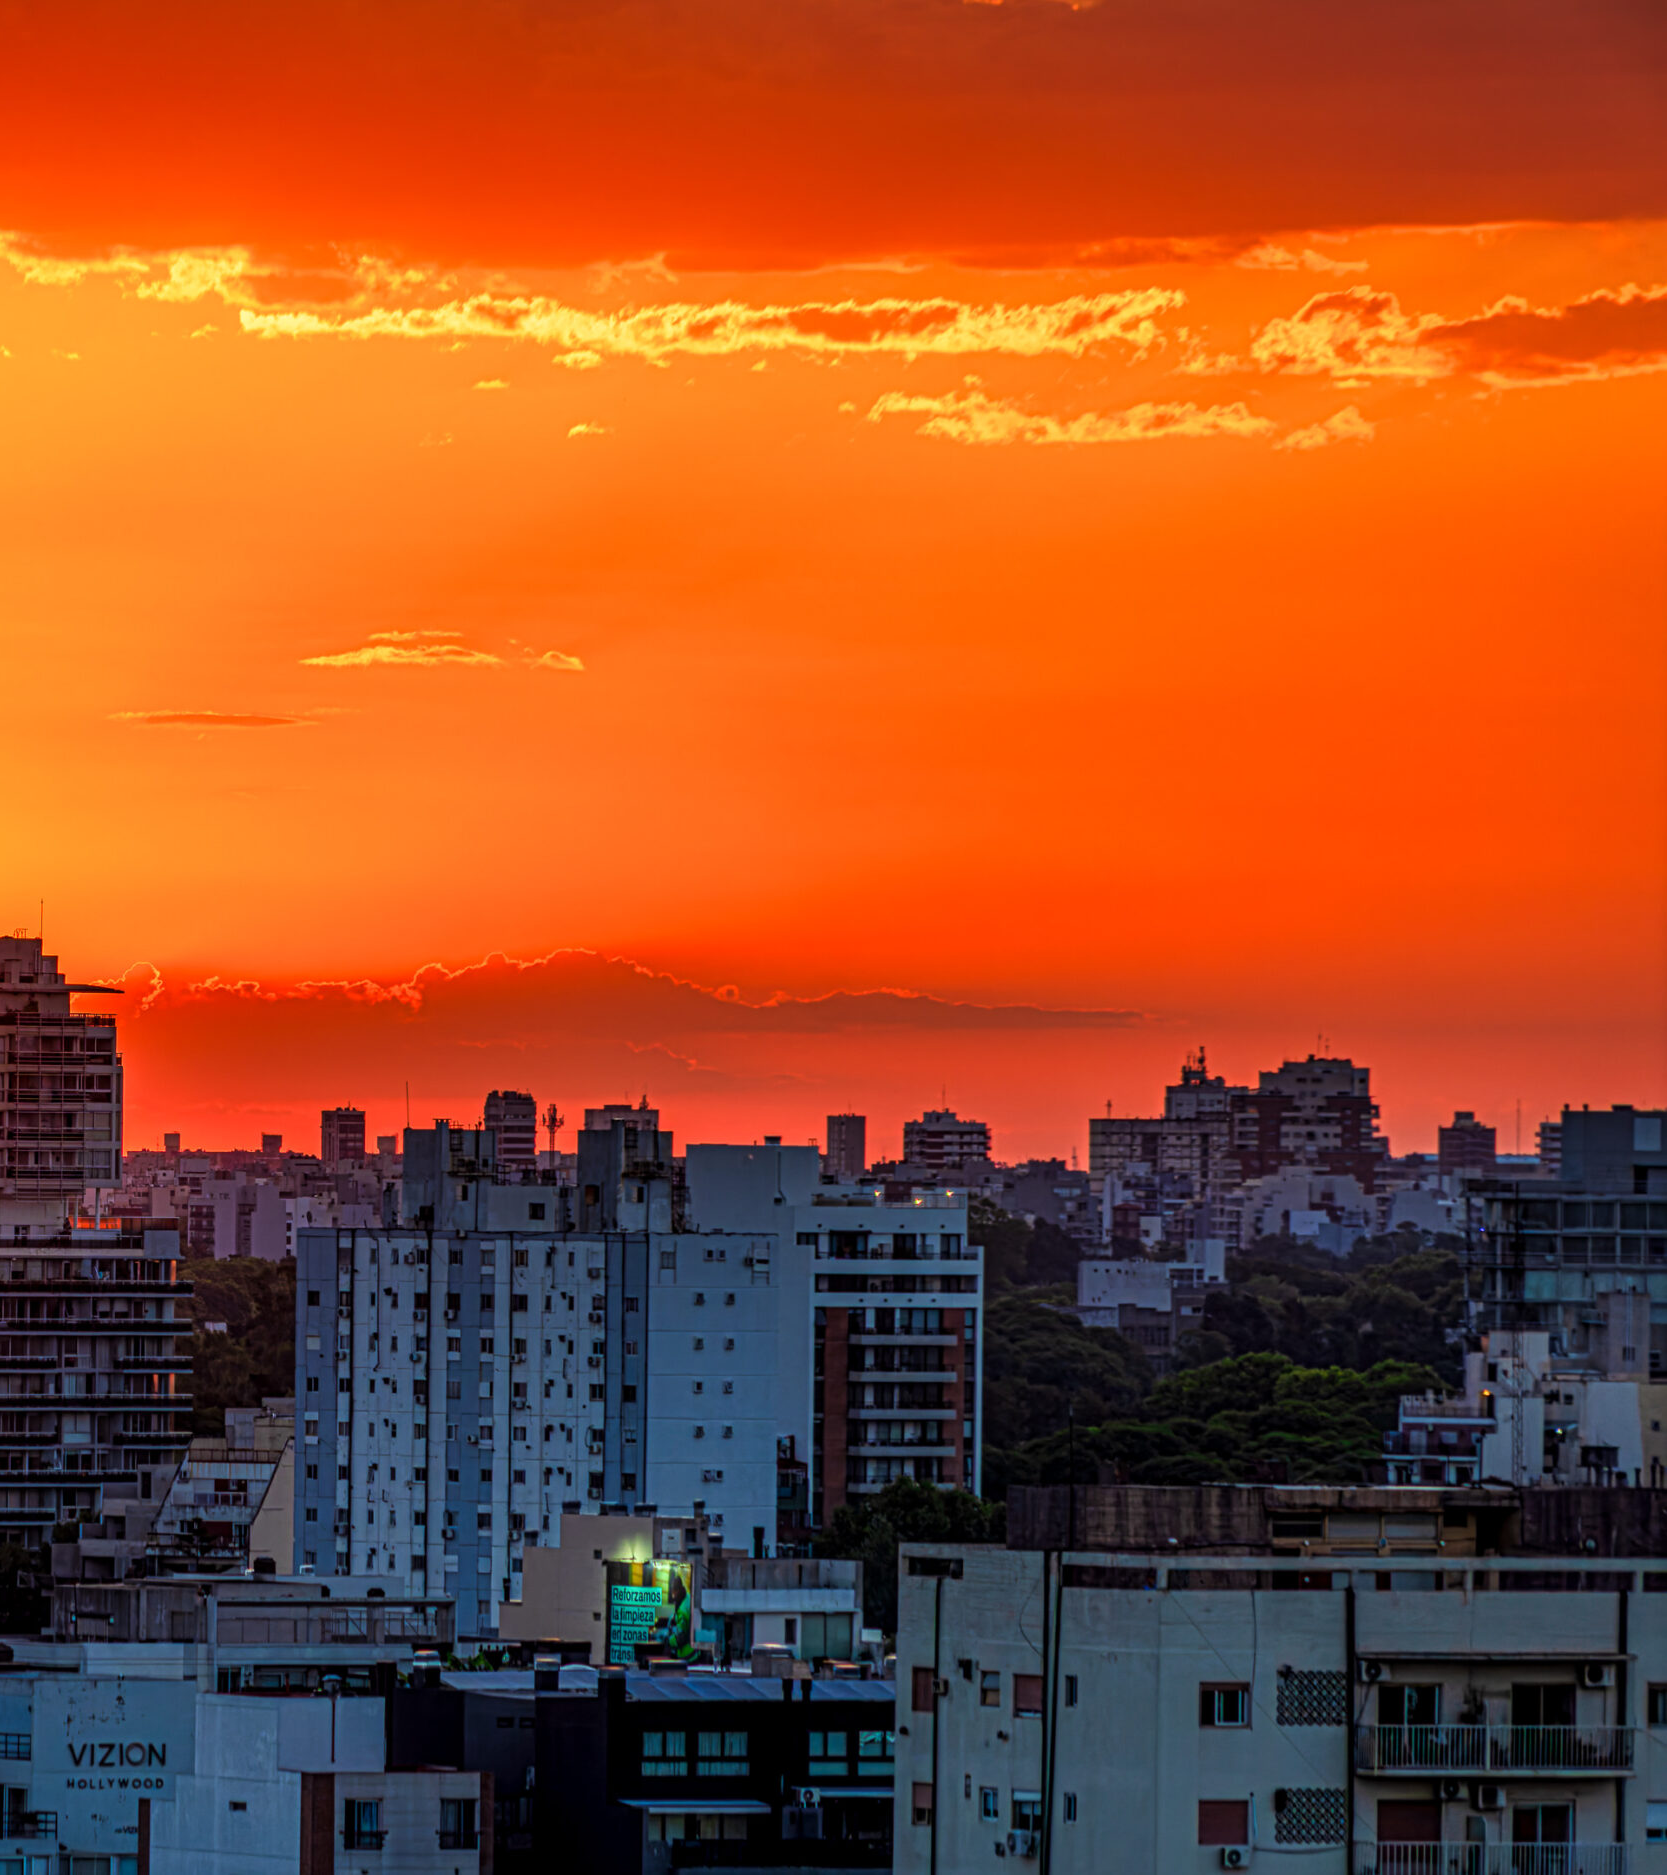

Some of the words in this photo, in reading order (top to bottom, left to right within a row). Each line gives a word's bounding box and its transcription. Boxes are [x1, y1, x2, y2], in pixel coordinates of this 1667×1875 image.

[613, 1588, 661, 1602] Reforzamos
[613, 1608, 619, 1620] la
[621, 1608, 654, 1623] limpieza
[612, 1630, 621, 1640] en
[623, 1630, 647, 1641] zonas
[68, 1742, 166, 1767] VIZION
[67, 1778, 164, 1789] HOLLYWOOD
